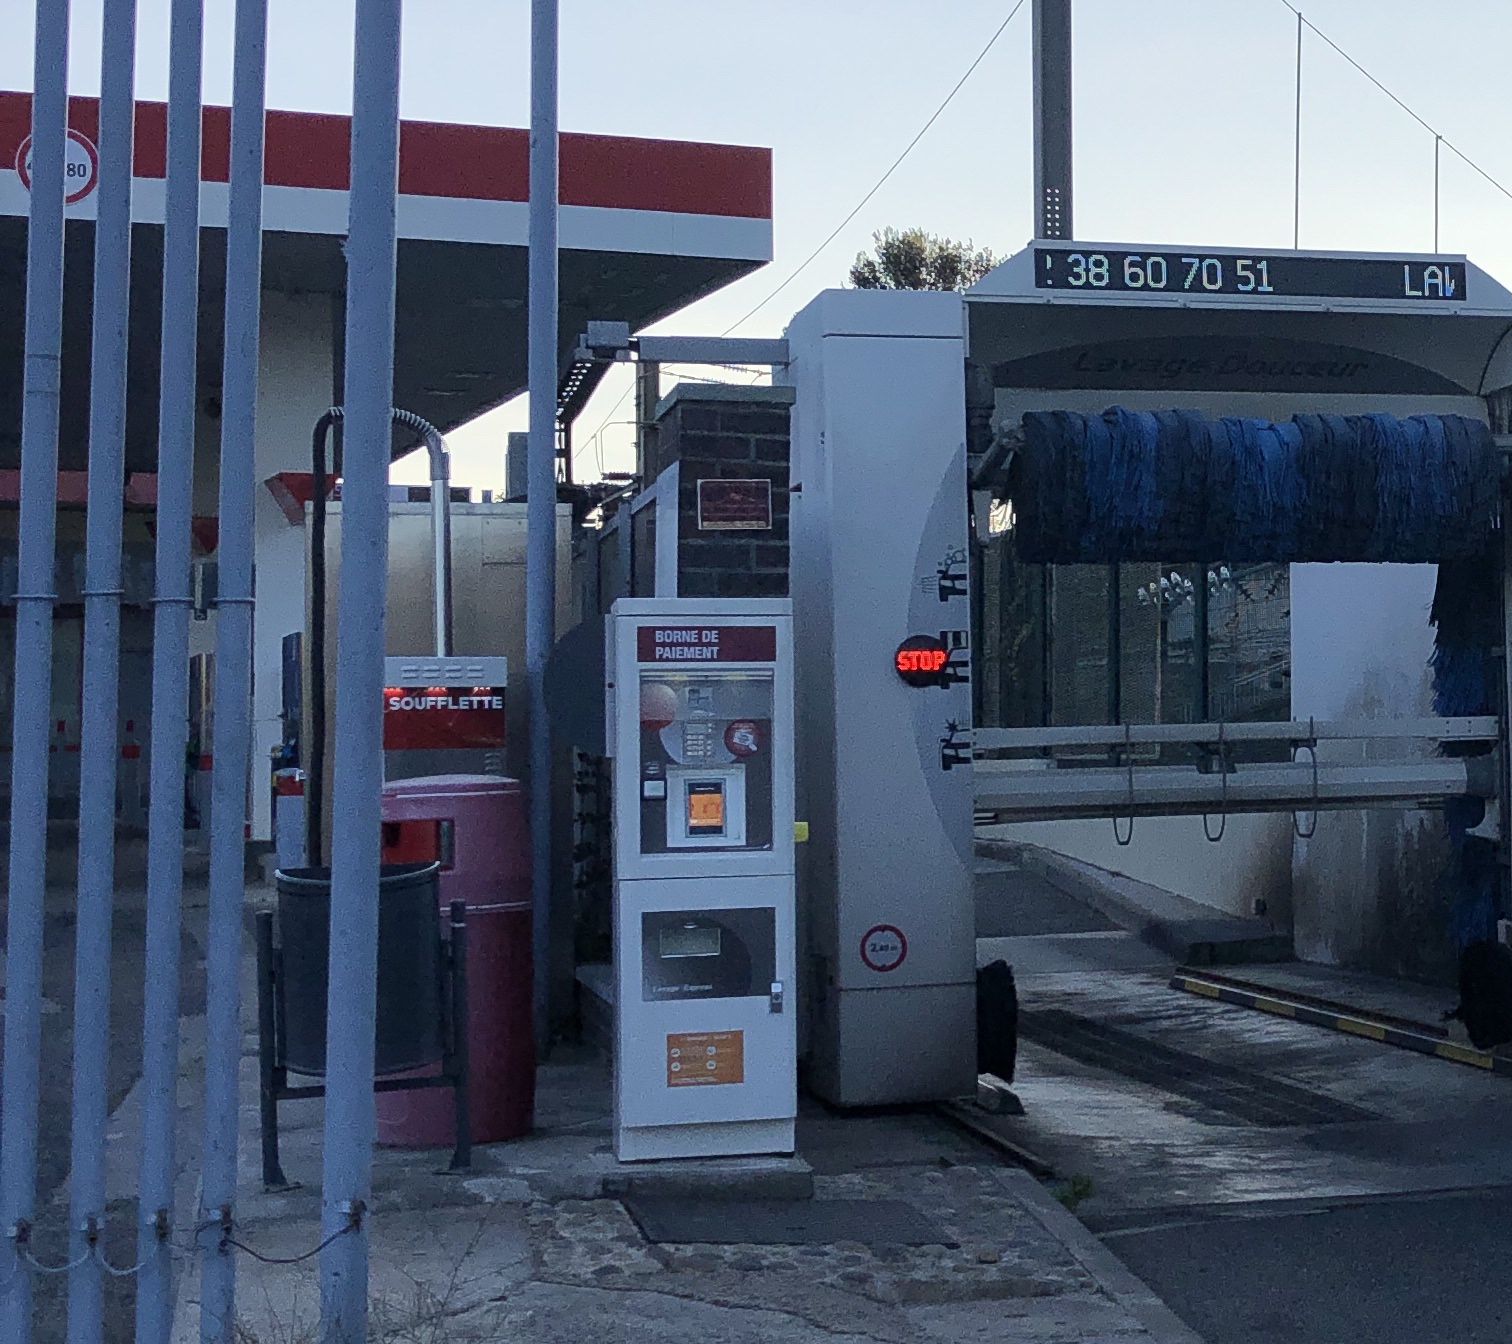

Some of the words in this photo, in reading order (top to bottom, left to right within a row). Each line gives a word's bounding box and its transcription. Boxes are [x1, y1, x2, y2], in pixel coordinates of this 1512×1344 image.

[1067, 253, 1109, 287] 38
[1122, 255, 1167, 289] 60
[1180, 257, 1224, 291] 70
[1235, 259, 1274, 293] 51
[1073, 347, 1212, 379] Lavage
[1218, 352, 1369, 379] Douceur
[655, 630, 699, 643] BORNE
[702, 630, 720, 643] DE
[655, 646, 720, 660] PAIEMENT
[897, 650, 947, 672] STOP
[389, 696, 504, 711] SOUFFLETTE
